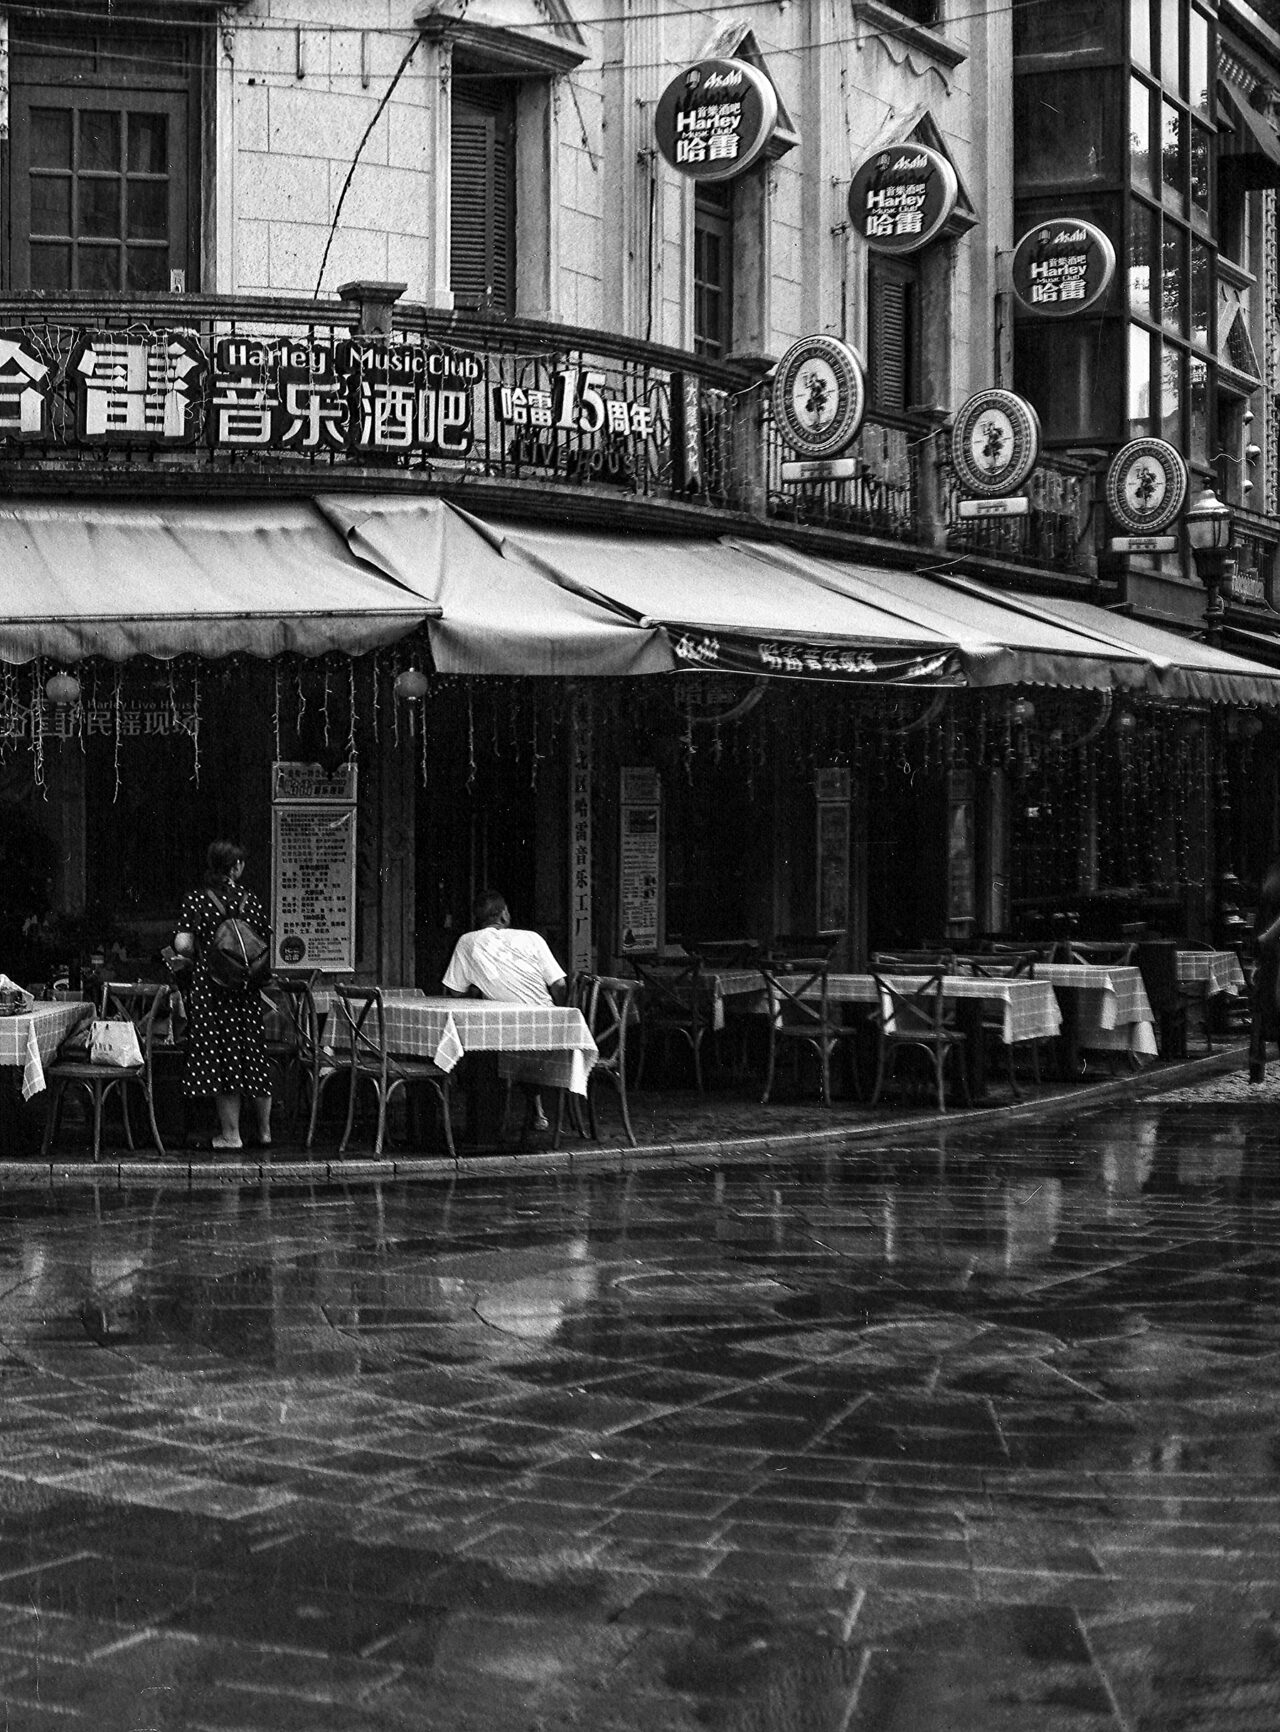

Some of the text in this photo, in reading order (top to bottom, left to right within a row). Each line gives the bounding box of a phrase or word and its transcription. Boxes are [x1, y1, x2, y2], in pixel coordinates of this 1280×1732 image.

[703, 70, 742, 89] Asahi
[677, 110, 741, 132] Harley
[676, 133, 740, 163] 哈雷
[867, 189, 926, 209] Harley
[866, 211, 924, 236] 哈雷
[1053, 229, 1087, 243] Asahi
[1031, 262, 1087, 278] Harley
[1032, 279, 1086, 303] 哈雷
[229, 345, 479, 379] Harley Music Club
[213, 376, 470, 450] 音乐酒吧
[519, 440, 568, 467] LIVE
